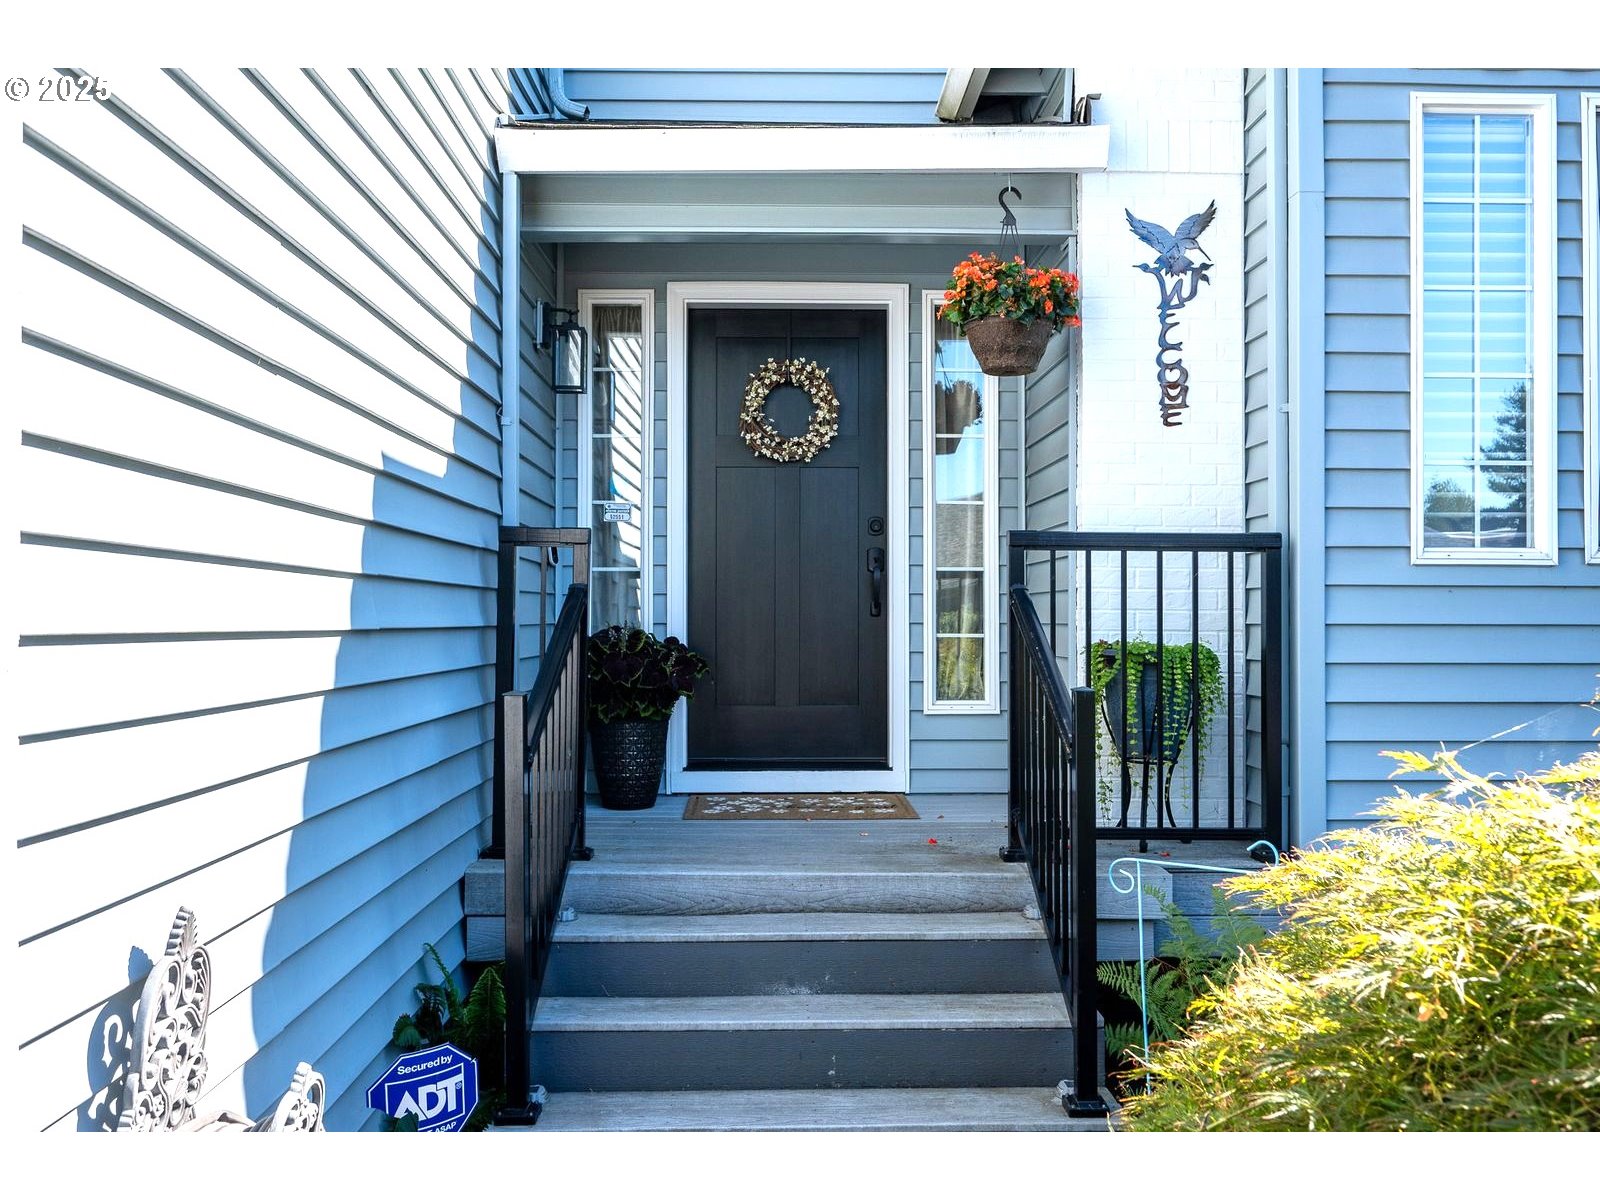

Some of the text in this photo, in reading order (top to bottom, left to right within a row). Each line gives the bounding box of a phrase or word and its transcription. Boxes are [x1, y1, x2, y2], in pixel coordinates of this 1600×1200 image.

[397, 1054, 453, 1075] Secured by
[394, 1073, 463, 1121] ADT
